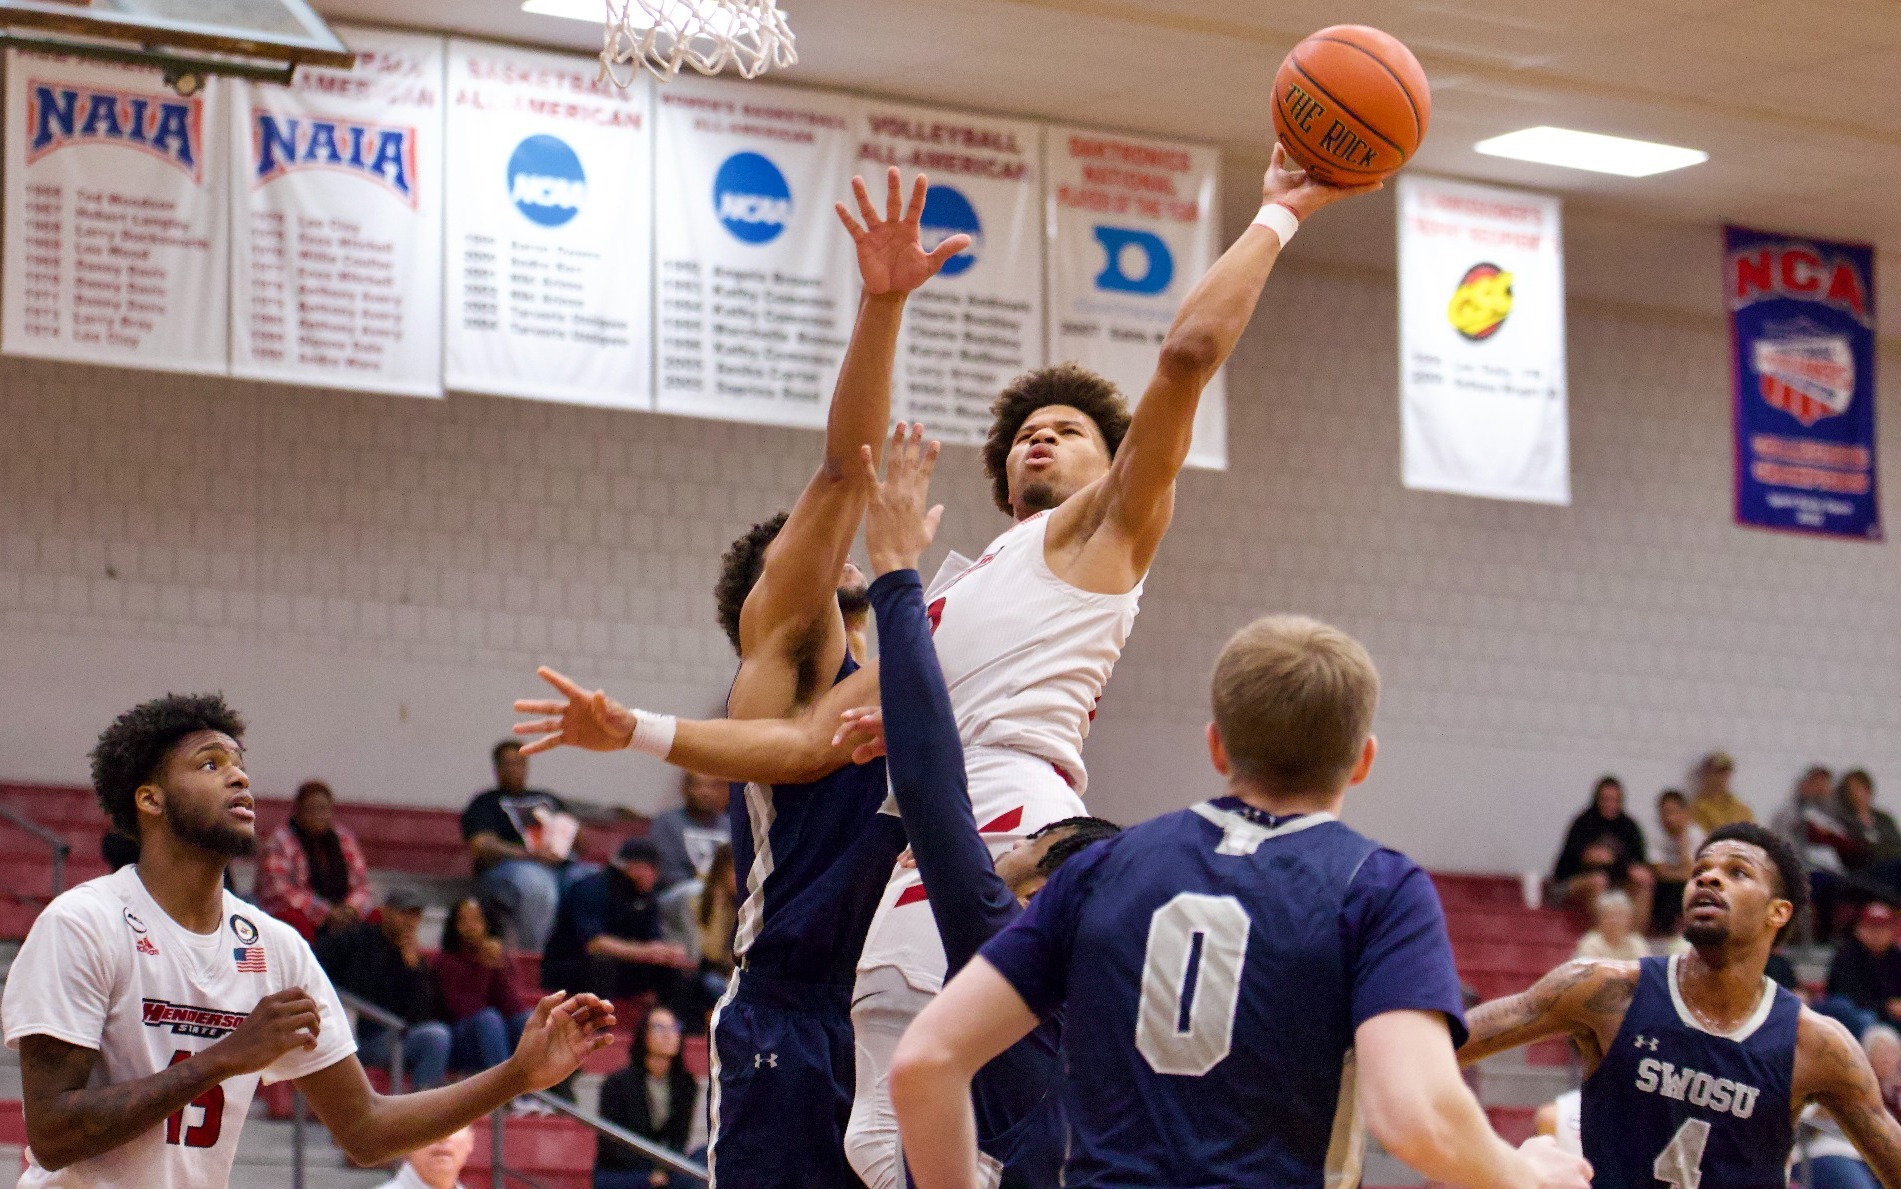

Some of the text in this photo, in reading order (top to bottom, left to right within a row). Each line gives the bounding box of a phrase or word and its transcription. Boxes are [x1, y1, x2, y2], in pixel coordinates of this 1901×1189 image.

[32, 86, 195, 170] NAIA
[257, 114, 410, 196] NAIA
[869, 117, 1022, 155] VOLLEYBALL
[1284, 82, 1379, 167] THE ROCK
[719, 193, 793, 224] NCAA
[1737, 249, 1865, 315] NCA
[143, 1003, 245, 1029] HENDERSO
[1136, 892, 1251, 1077] 0
[1636, 1058, 1760, 1119] SWOSU
[1654, 1117, 1711, 1189] 4
